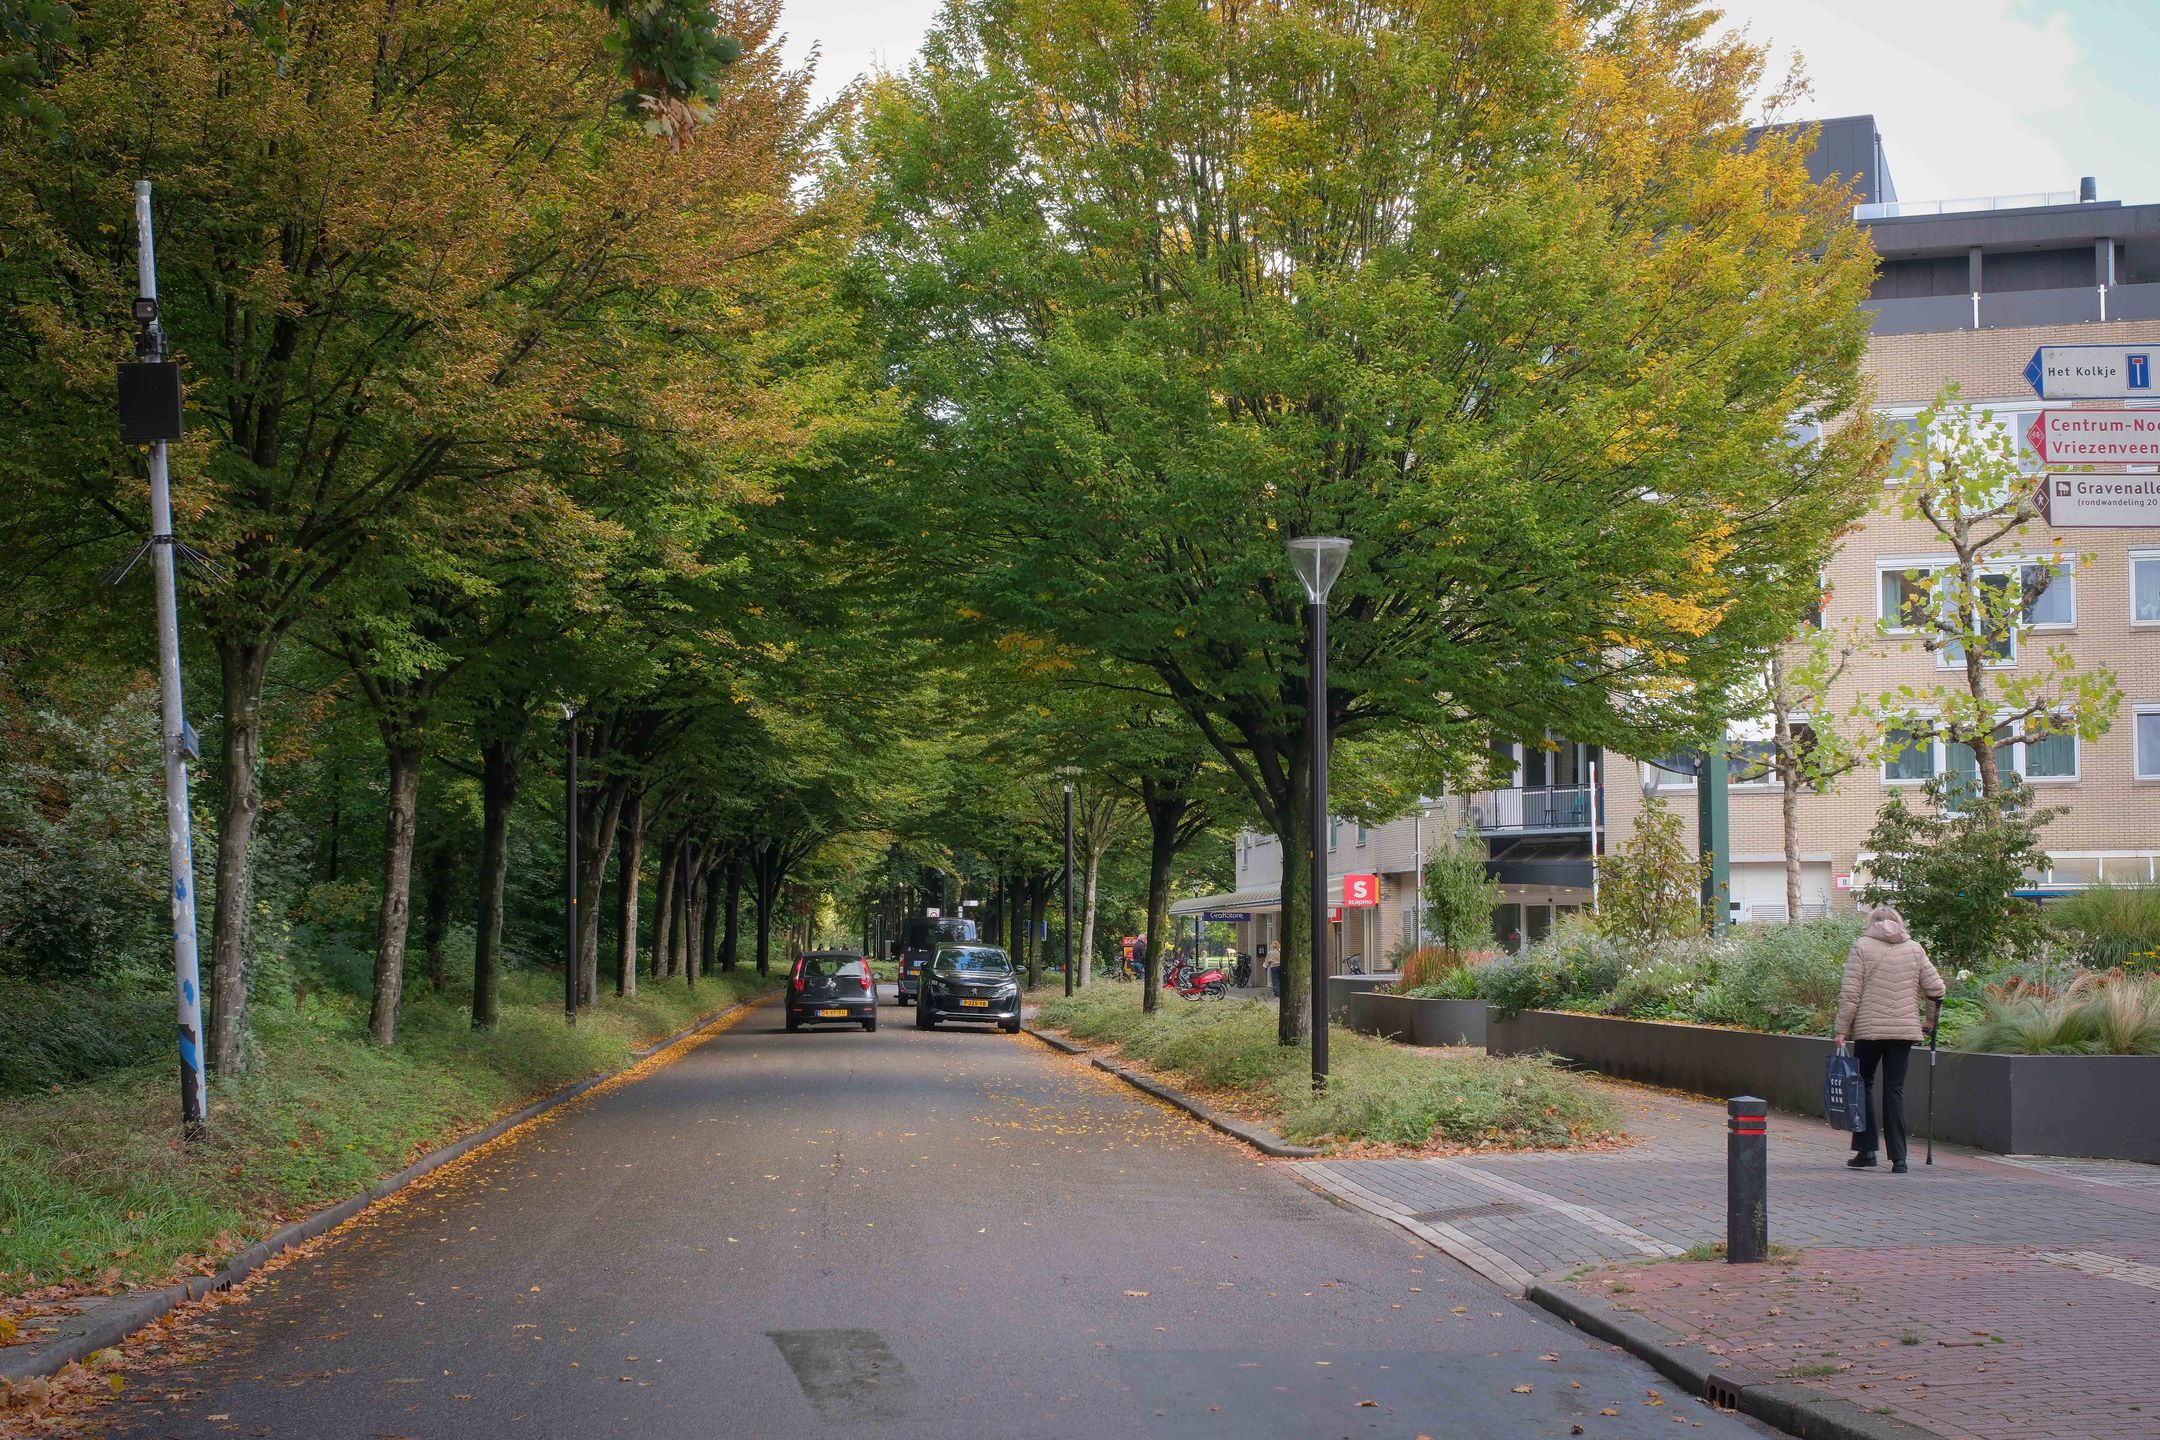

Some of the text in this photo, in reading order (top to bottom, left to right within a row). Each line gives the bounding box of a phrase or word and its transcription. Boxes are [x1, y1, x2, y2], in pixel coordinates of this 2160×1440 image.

[2048, 366, 2117, 378] Het Kolkje
[2051, 418, 2160, 432] Centrum-No
[2052, 441, 2159, 454] Vriezenveen
[2077, 498, 2145, 507] (rondwandeling
[1353, 881, 1367, 898] S
